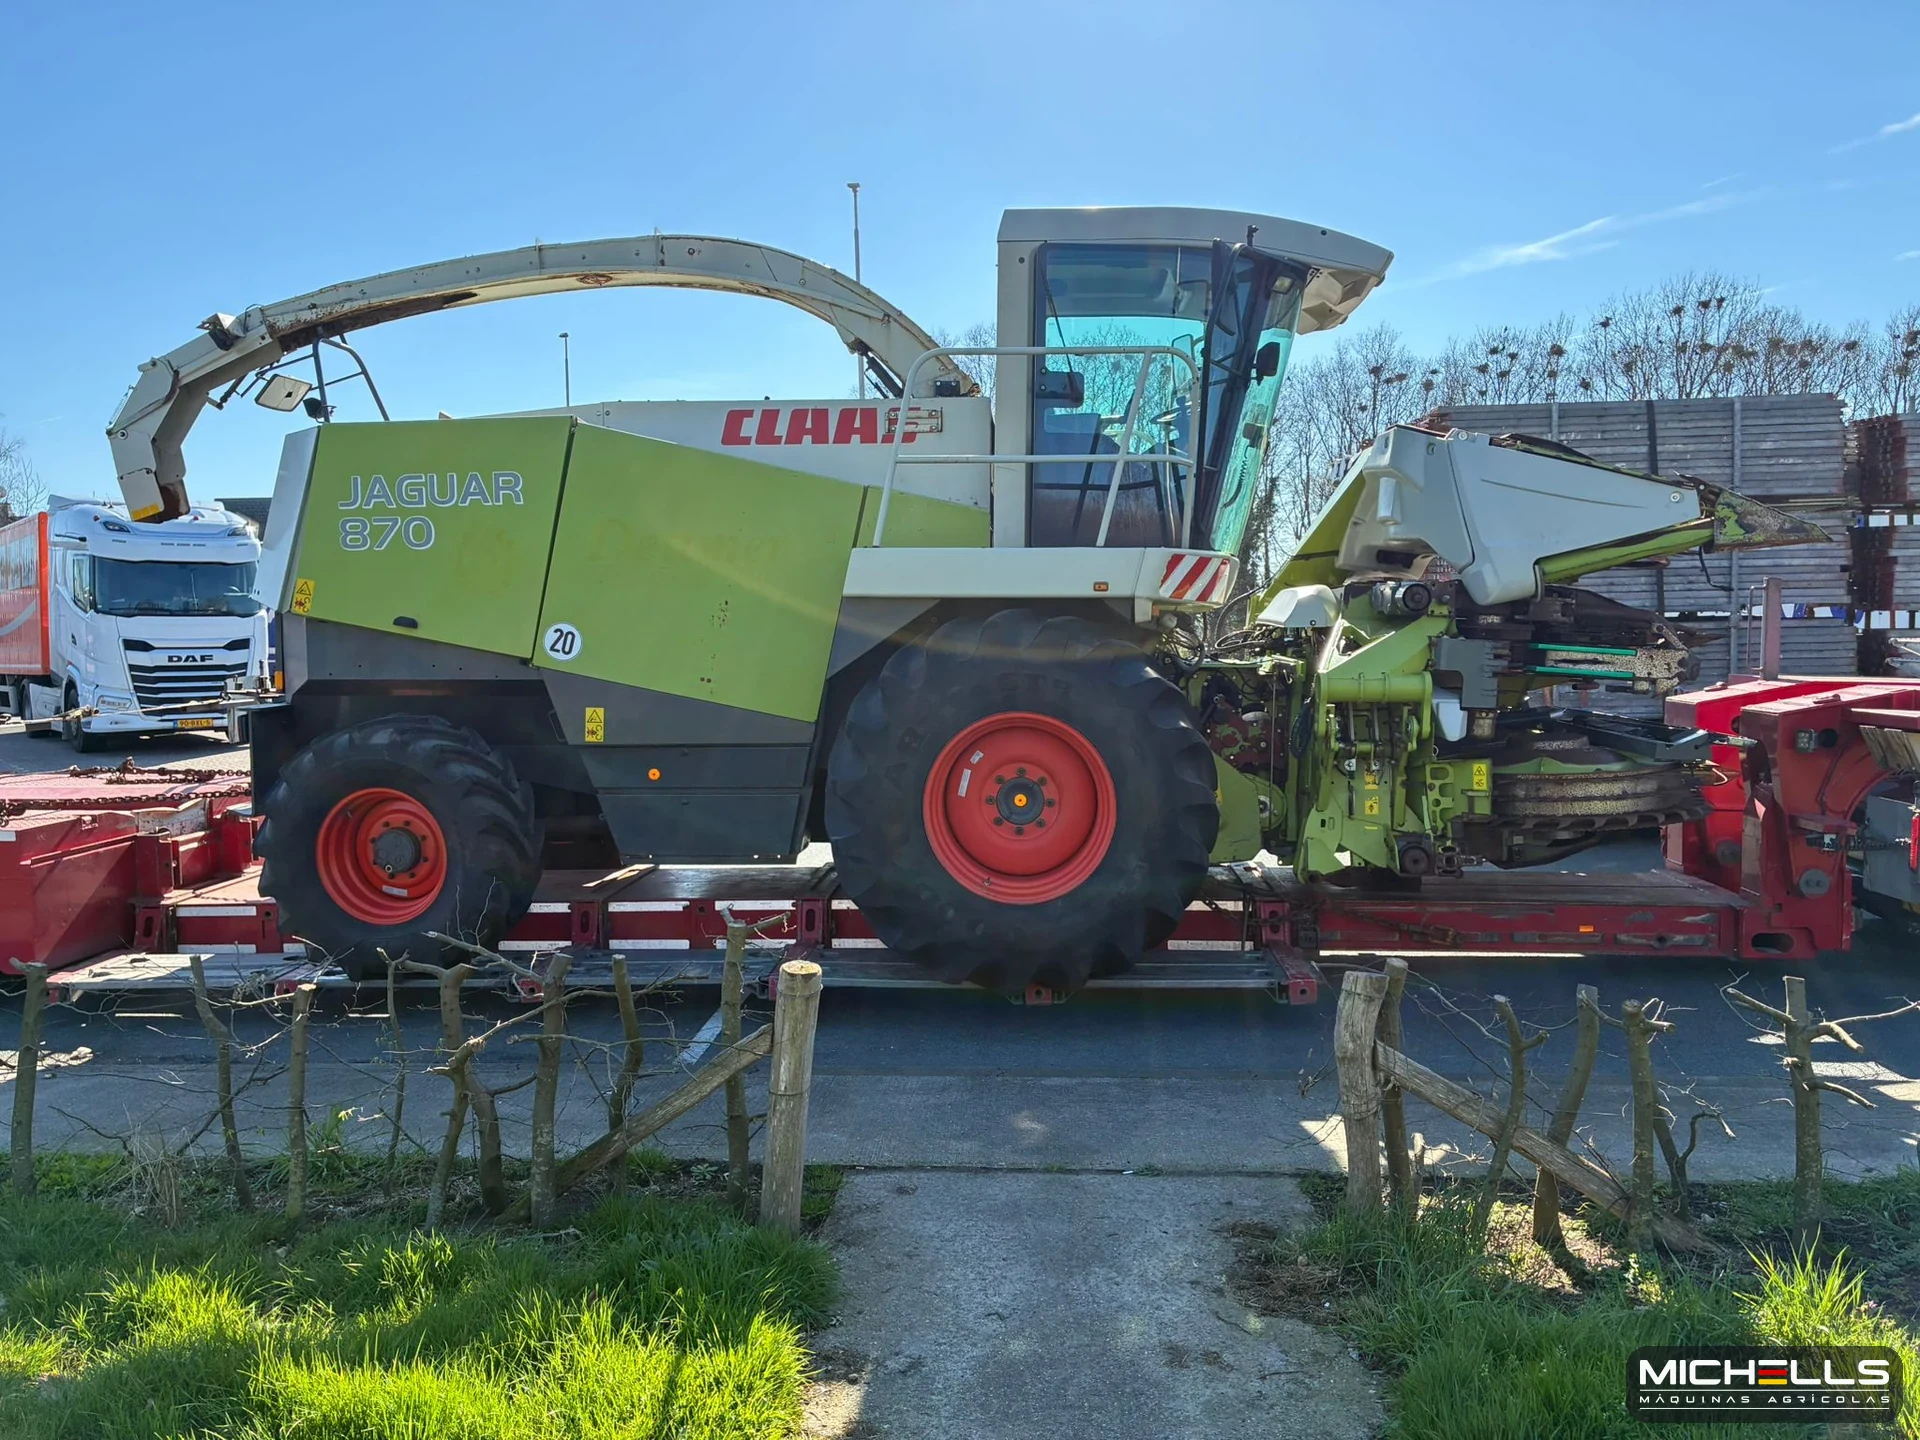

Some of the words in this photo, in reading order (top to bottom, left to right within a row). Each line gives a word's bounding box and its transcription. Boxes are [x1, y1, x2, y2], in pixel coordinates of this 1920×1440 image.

[338, 471, 524, 510] JAGUAR
[339, 515, 435, 551] 870
[549, 628, 576, 656] 20
[167, 654, 214, 663] DAF
